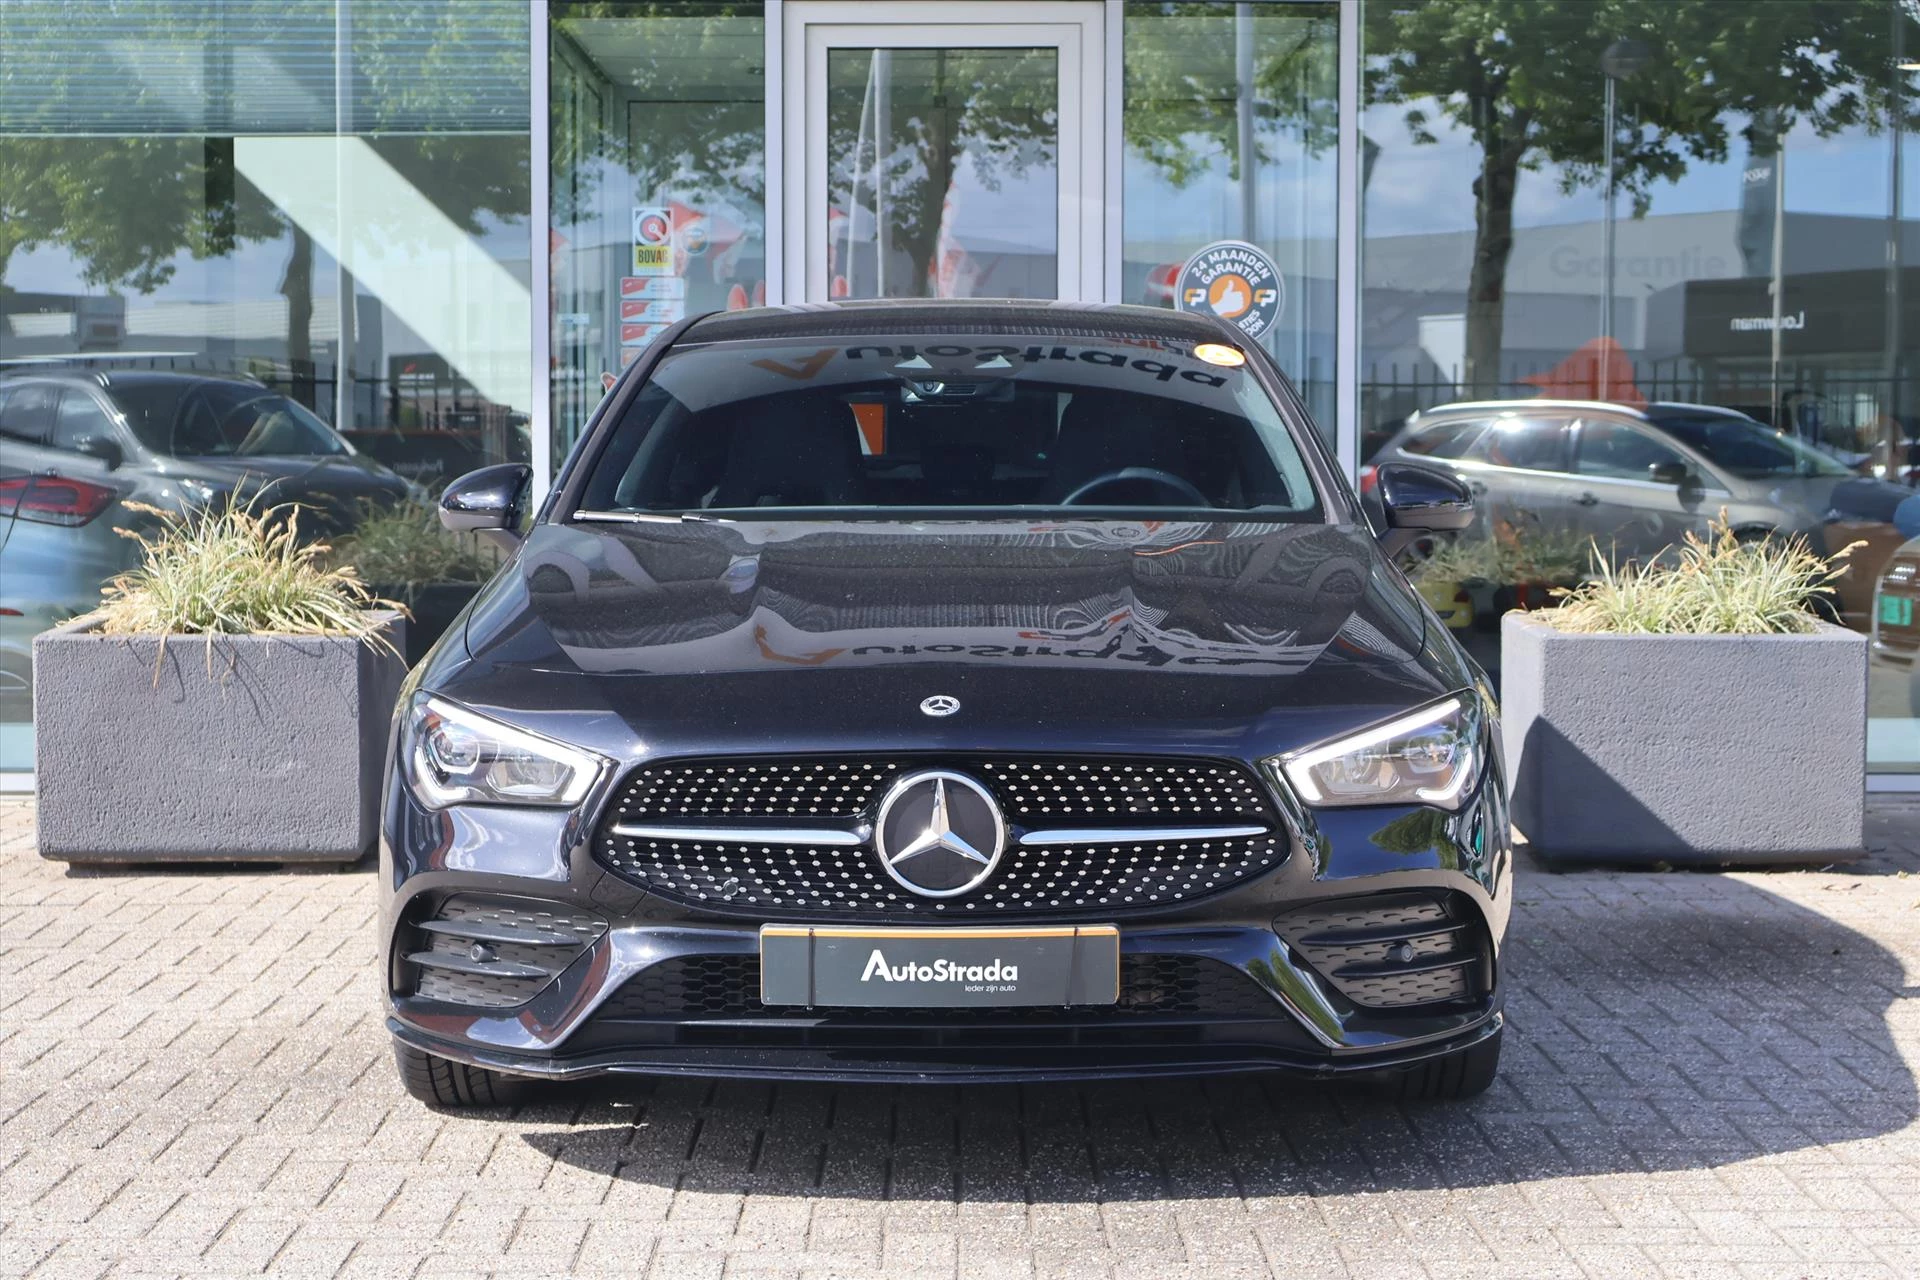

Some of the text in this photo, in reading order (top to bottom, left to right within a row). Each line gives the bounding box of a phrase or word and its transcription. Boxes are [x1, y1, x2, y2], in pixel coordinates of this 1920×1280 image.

[638, 248, 669, 264] BOVAG
[1192, 249, 1271, 279] 24 MAANDEN
[1201, 262, 1261, 286] GARANTIE
[860, 949, 1018, 982] AutoStrada
[985, 984, 998, 994] zijn
[999, 984, 1017, 993] auto
